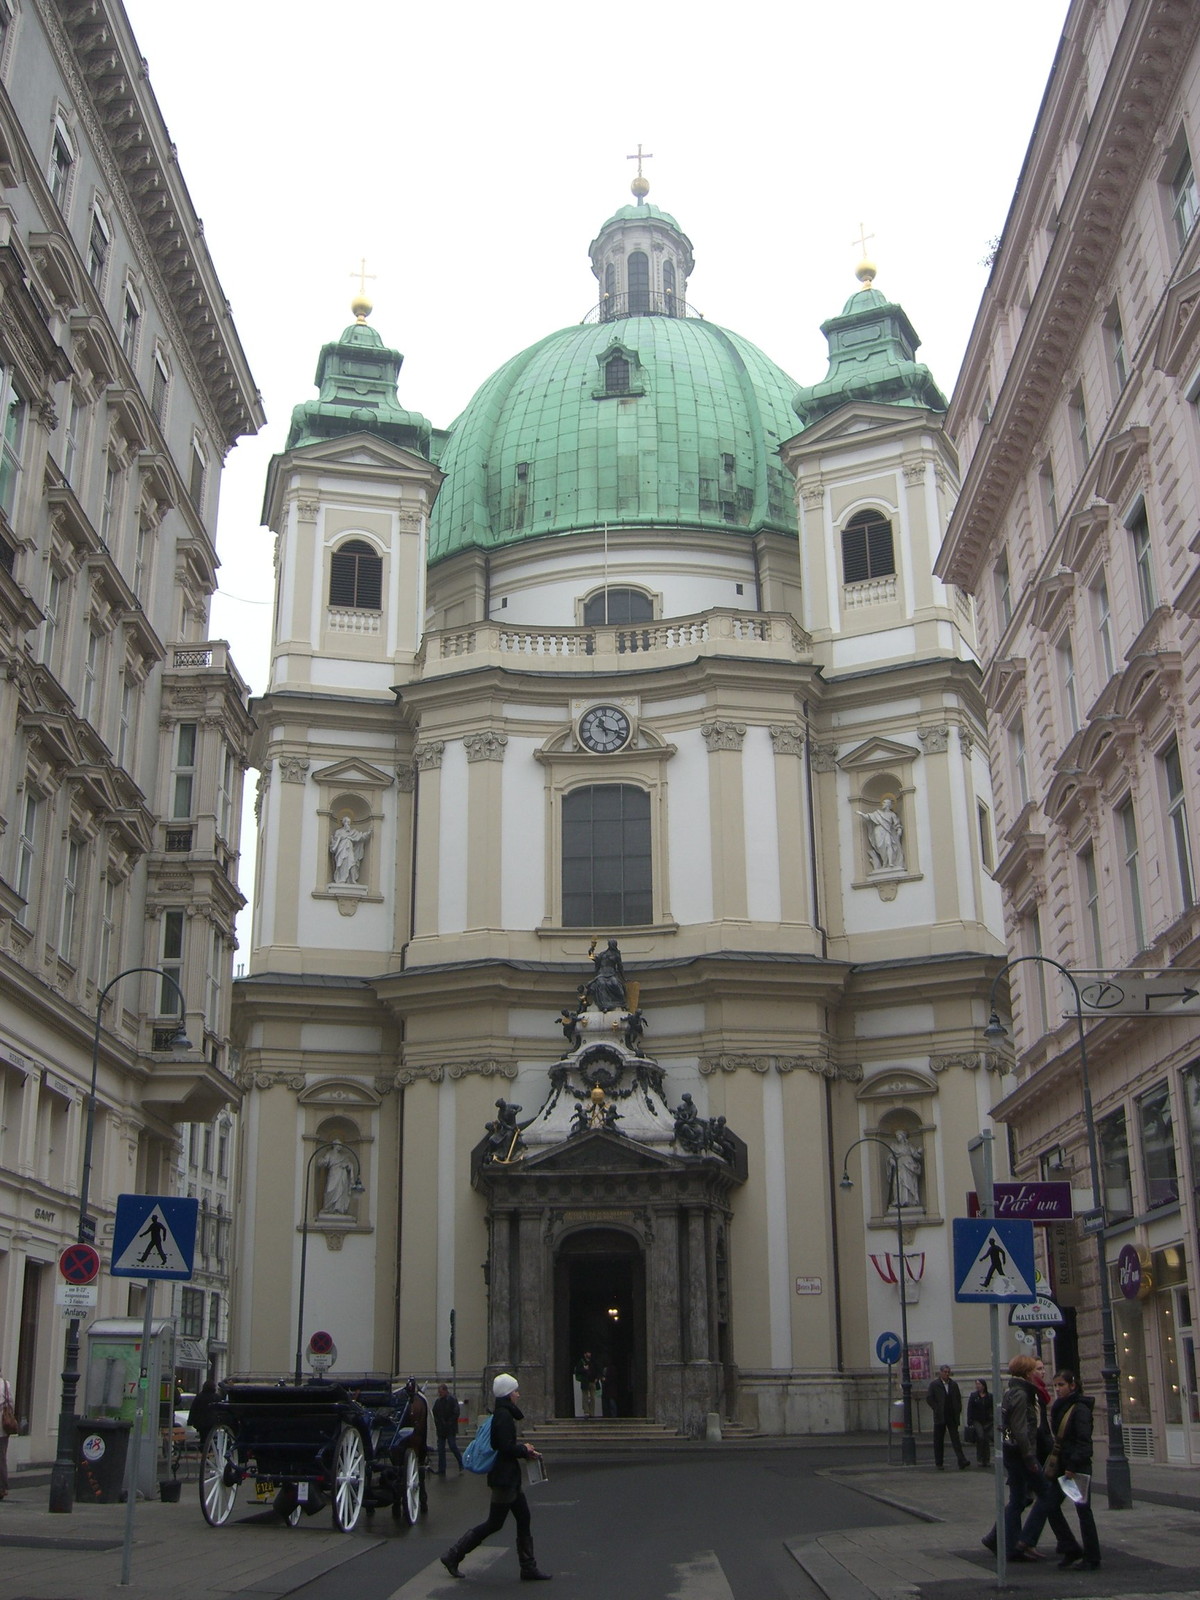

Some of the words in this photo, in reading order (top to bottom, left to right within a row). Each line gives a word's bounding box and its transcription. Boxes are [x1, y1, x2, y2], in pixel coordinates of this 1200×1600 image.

[1017, 1186, 1035, 1202] Le
[34, 1208, 56, 1223] GANT
[65, 1308, 87, 1319] Anfang
[1016, 1313, 1058, 1321] HALTESTELLE
[87, 1438, 101, 1451] 48
